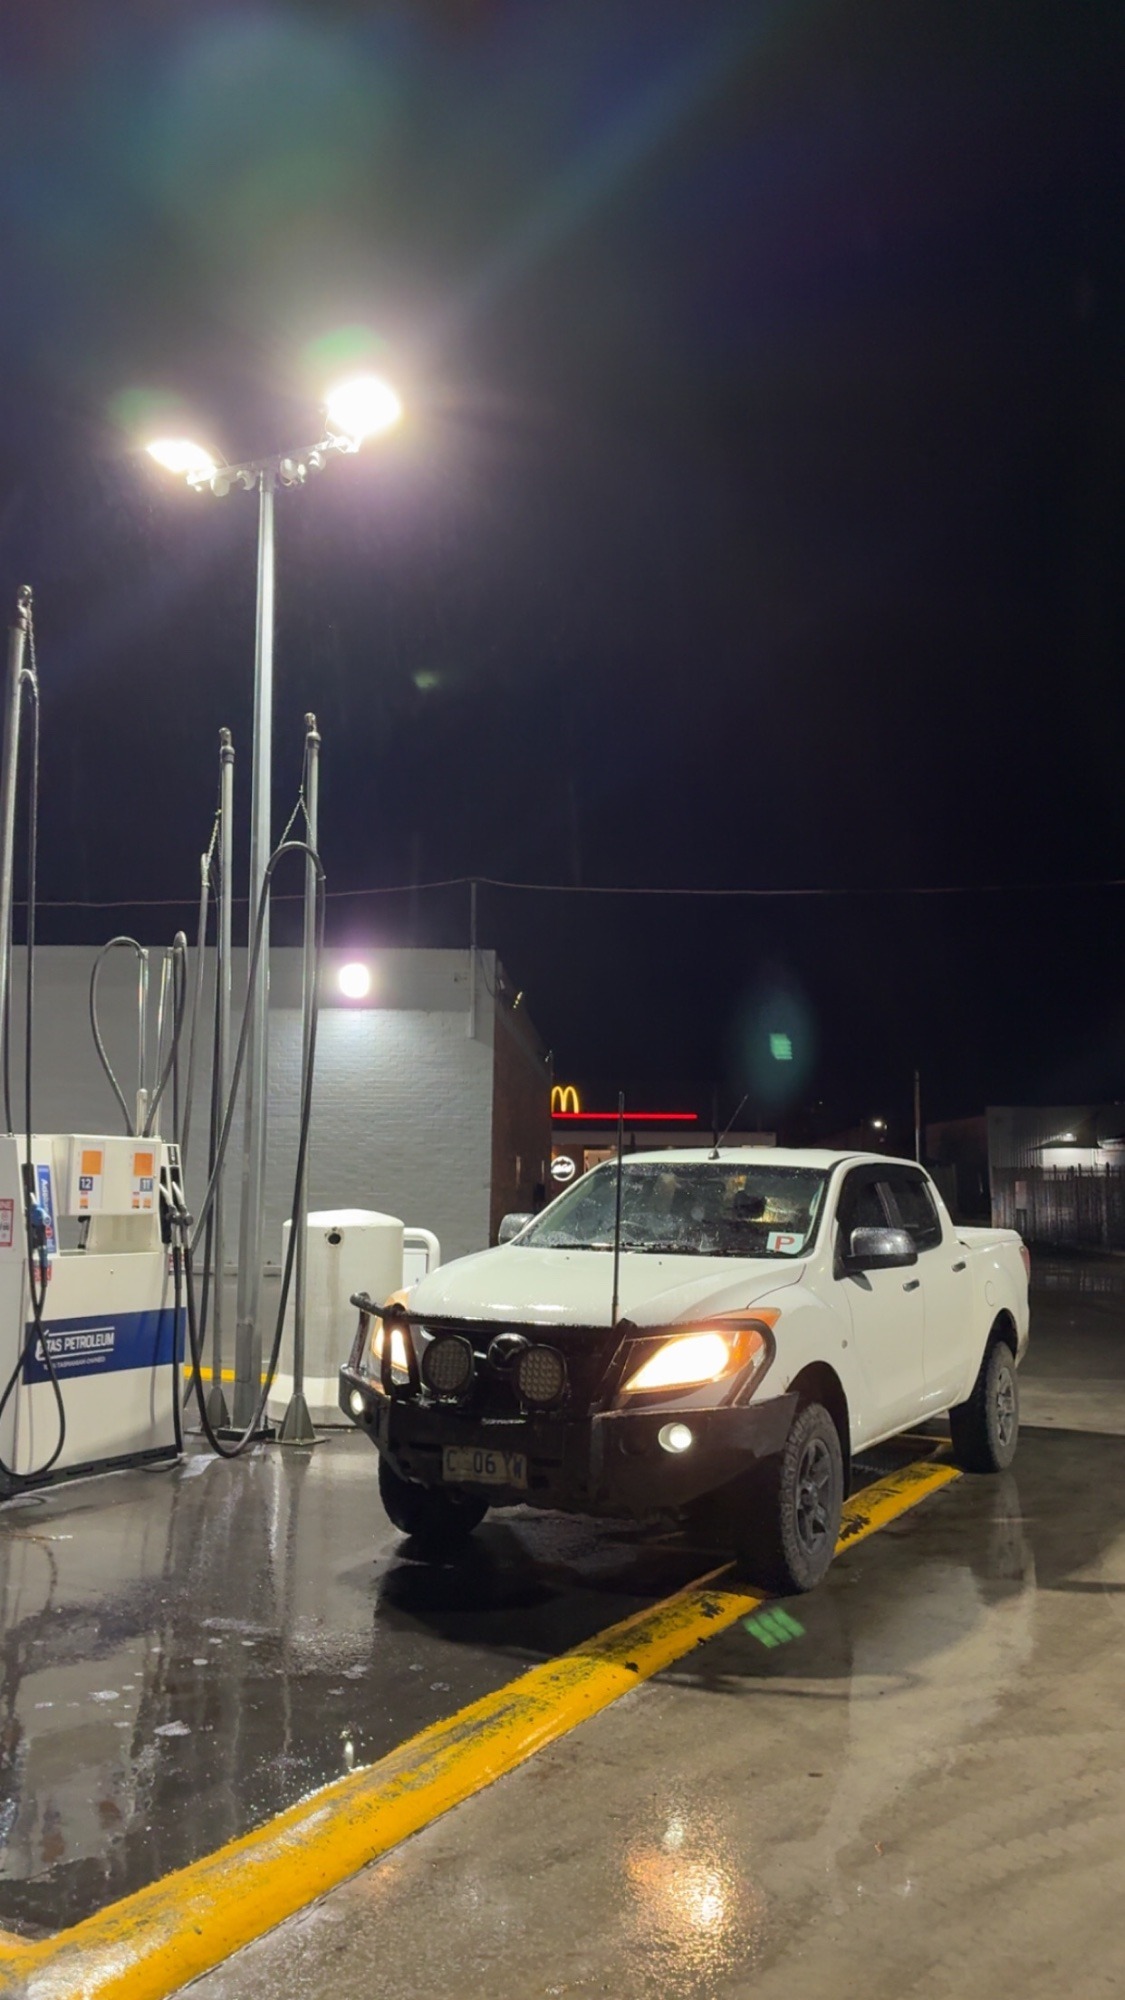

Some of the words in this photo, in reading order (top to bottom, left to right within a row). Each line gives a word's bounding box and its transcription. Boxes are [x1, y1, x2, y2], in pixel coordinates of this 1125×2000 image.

[81, 1178, 92, 1189] 12
[774, 1235, 795, 1251] P
[64, 1331, 115, 1351] PETROLEUM
